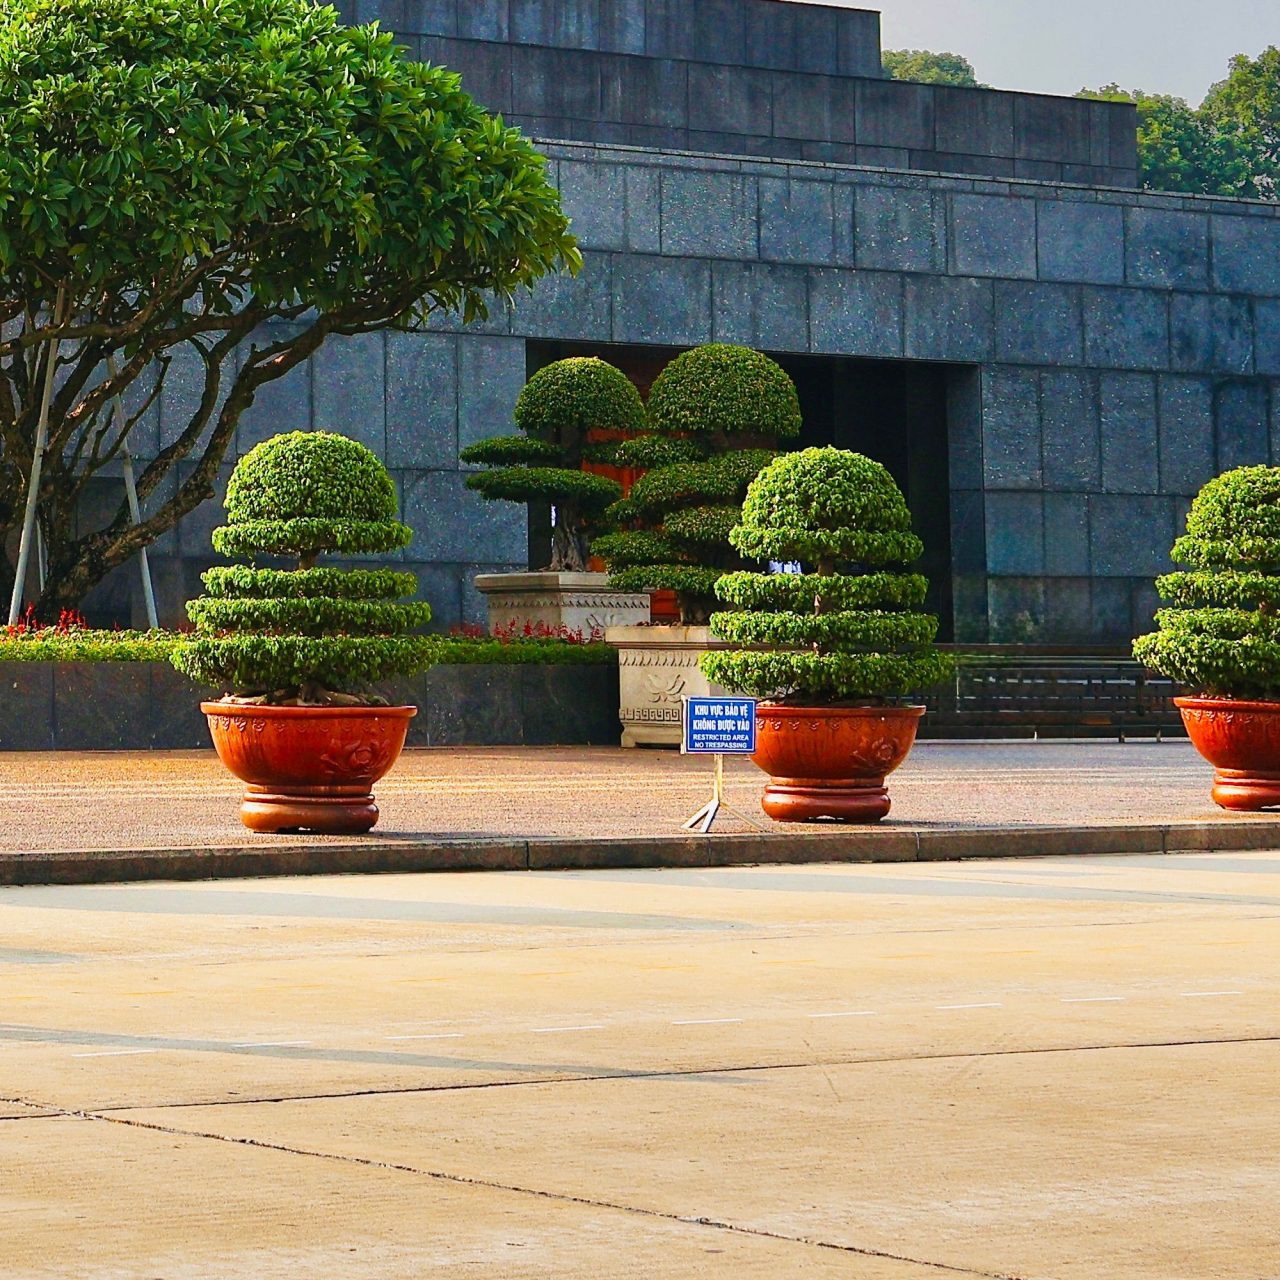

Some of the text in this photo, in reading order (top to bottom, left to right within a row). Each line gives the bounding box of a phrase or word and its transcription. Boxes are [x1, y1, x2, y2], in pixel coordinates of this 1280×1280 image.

[694, 702, 748, 718] KHU VỰC BẢO VỆ
[693, 718, 750, 732] KHÔNG ĐƯỢC VÀO
